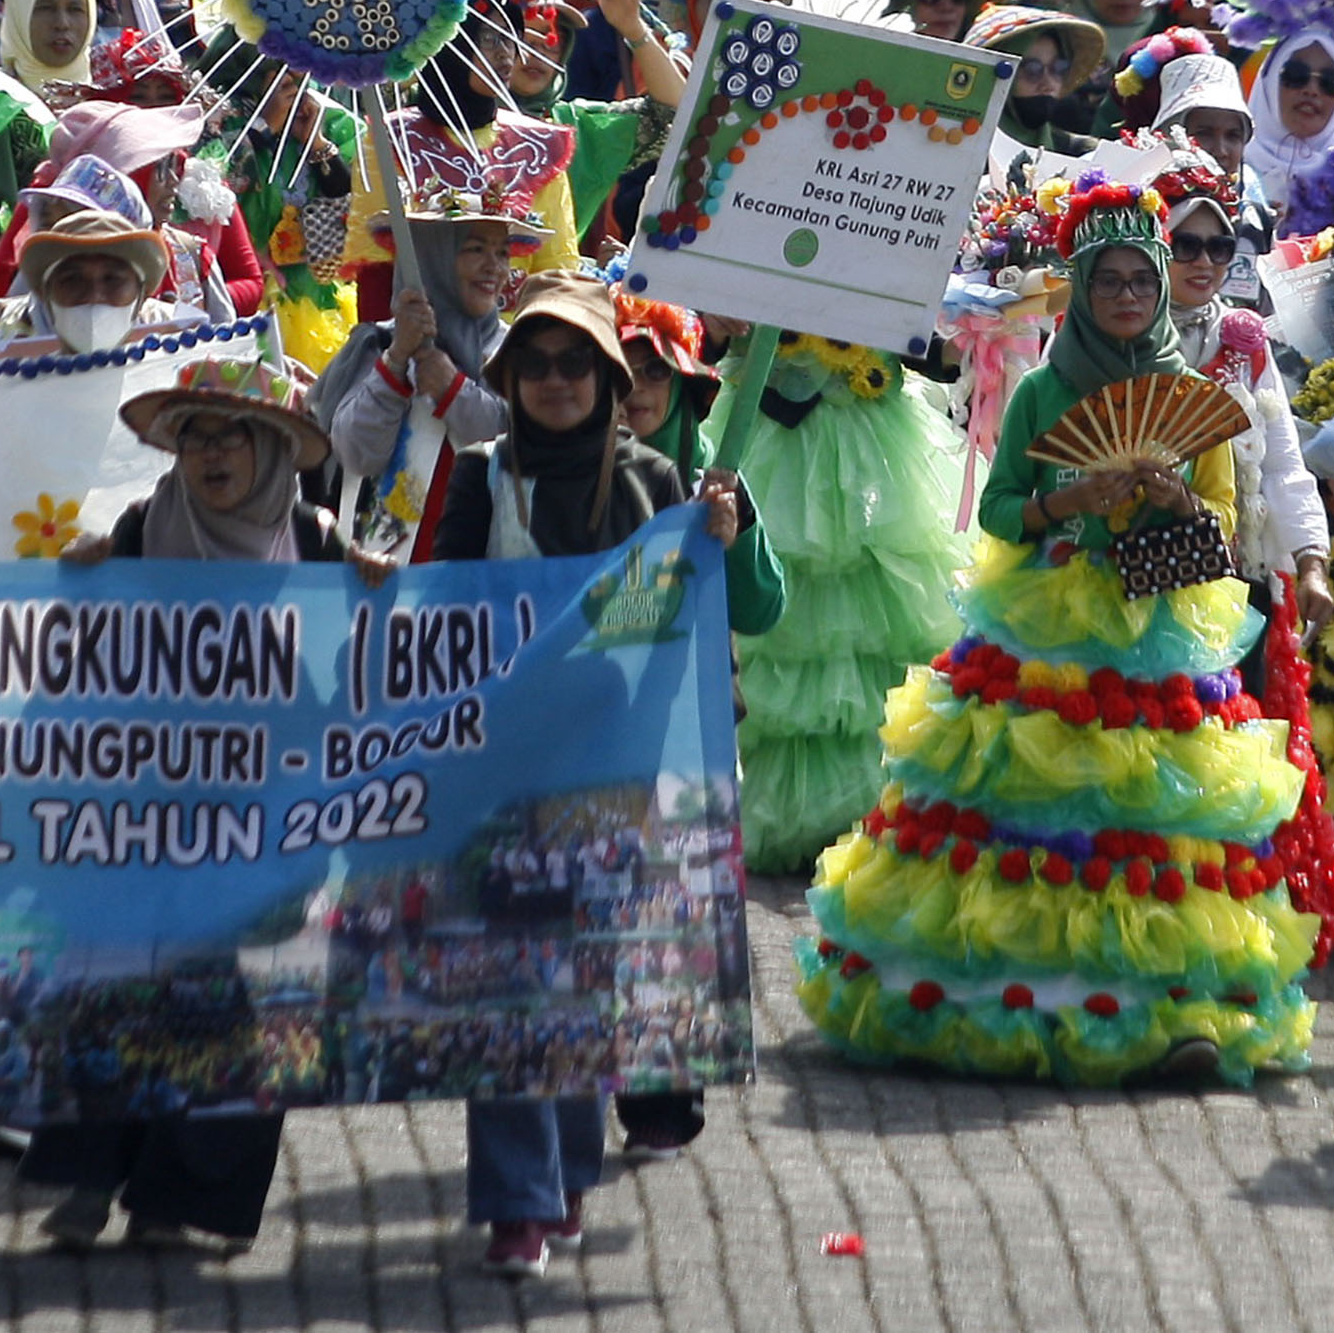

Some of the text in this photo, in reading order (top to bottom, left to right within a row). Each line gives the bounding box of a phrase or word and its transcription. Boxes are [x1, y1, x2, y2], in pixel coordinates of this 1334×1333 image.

[802, 181, 947, 227] Desa Tlajung Udik
[815, 158, 956, 203] KRL Asri 27 RW 27
[732, 191, 941, 251] Kecamatan Gunung Putri
[32, 798, 261, 865] TAHUN
[279, 772, 429, 854] 2022
